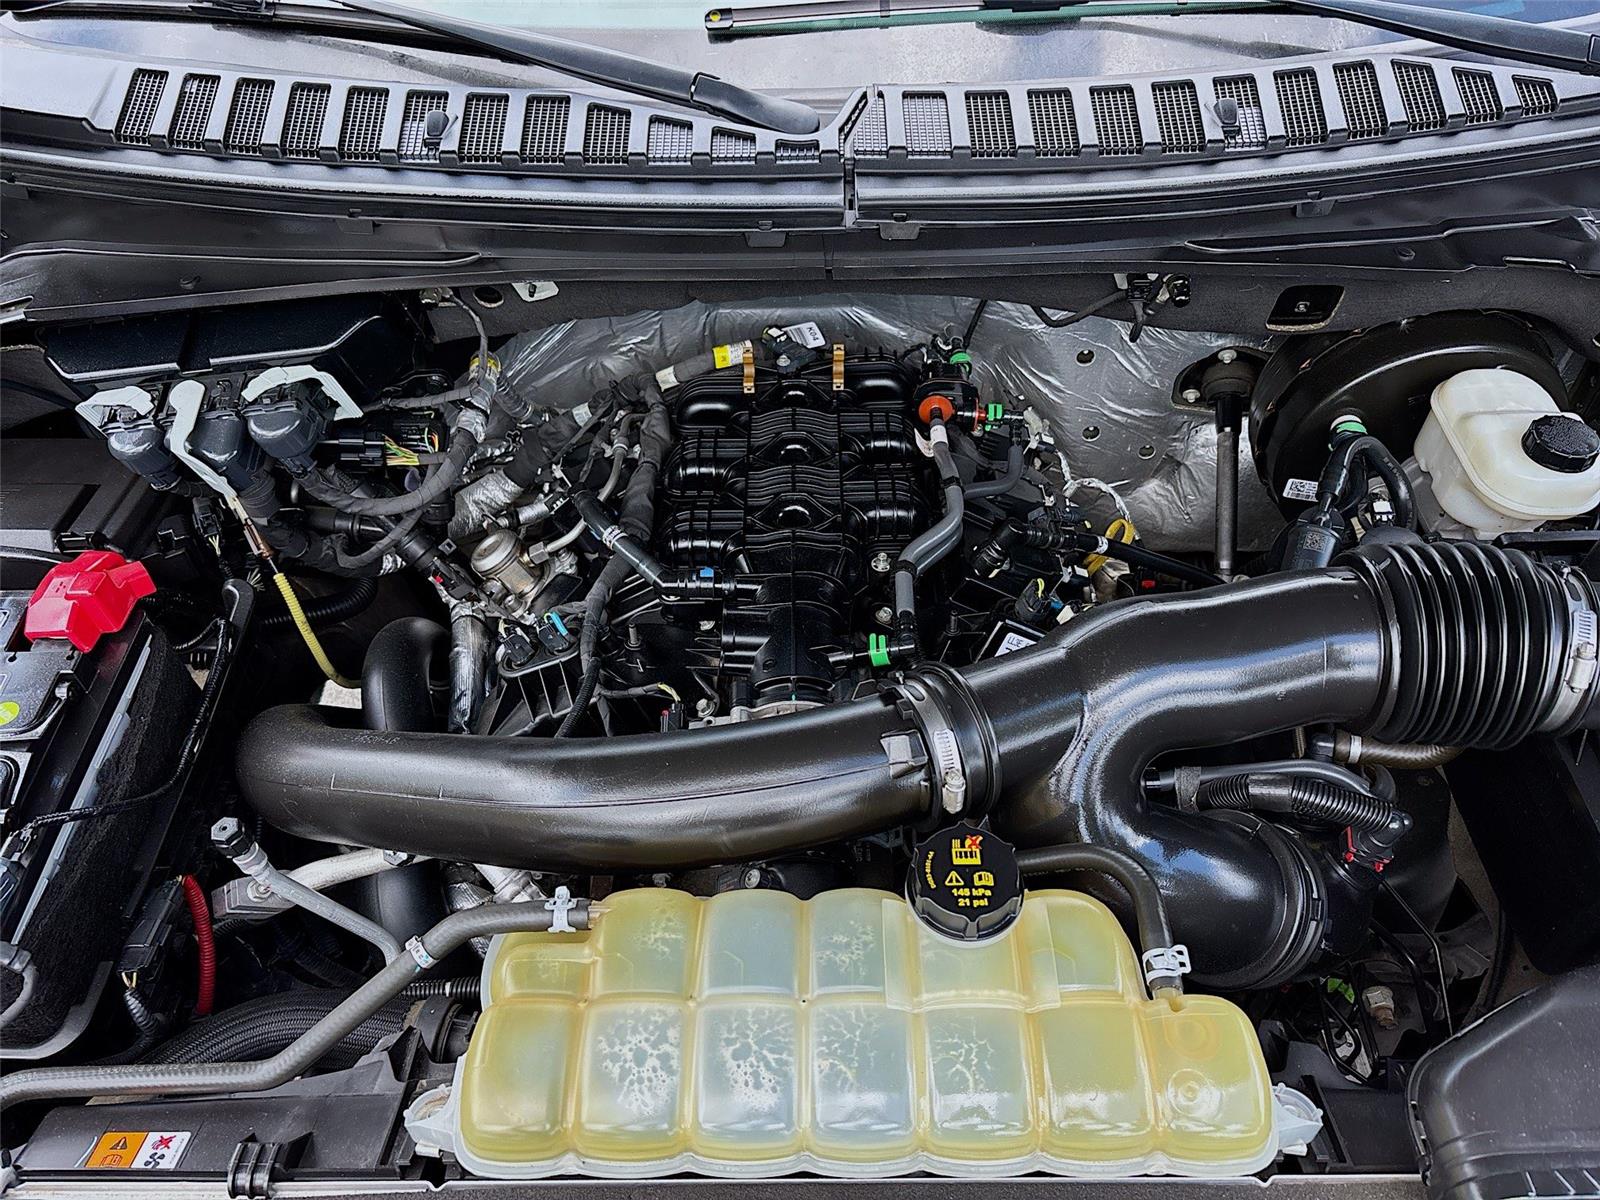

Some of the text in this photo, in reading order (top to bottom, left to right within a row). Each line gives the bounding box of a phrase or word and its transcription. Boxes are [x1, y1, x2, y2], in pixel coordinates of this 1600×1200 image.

[806, 327, 819, 341] K04
[952, 888, 992, 897] 145 kPa
[958, 898, 988, 908] 21 psi
